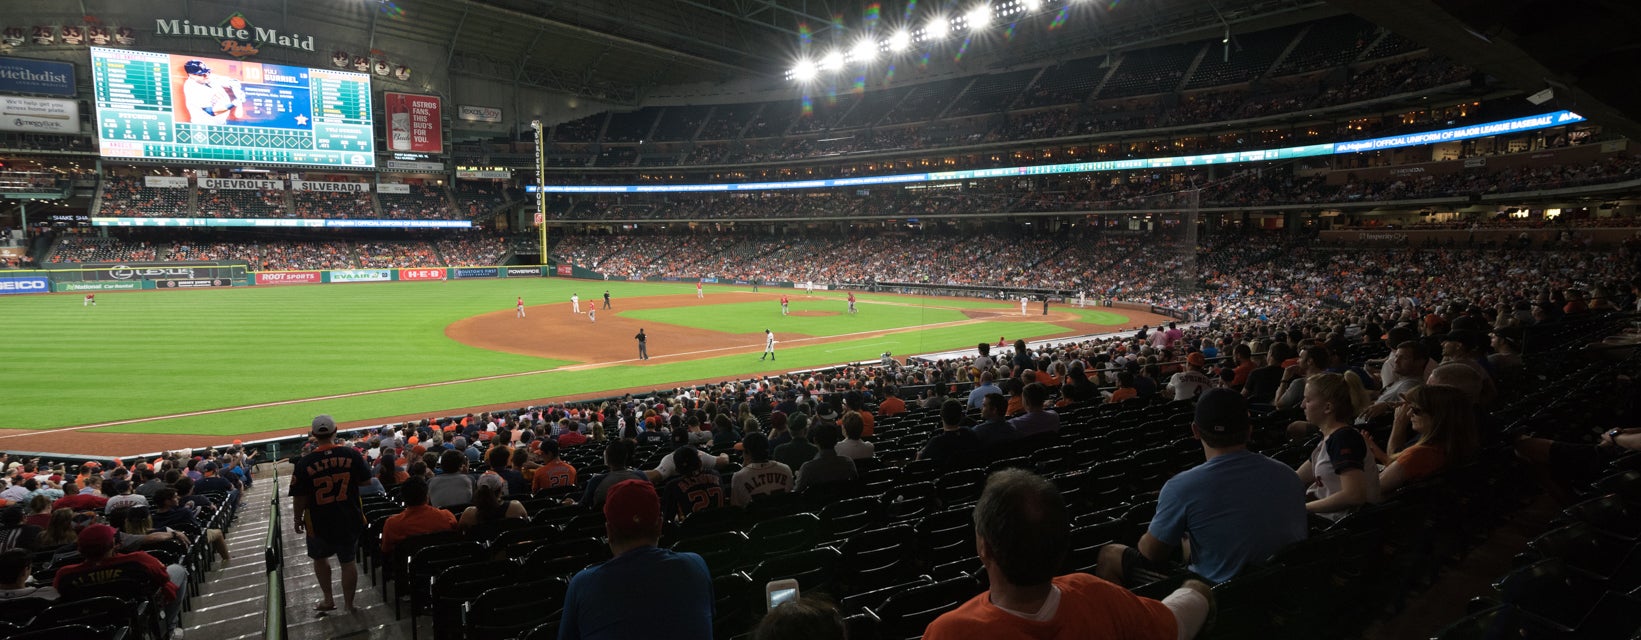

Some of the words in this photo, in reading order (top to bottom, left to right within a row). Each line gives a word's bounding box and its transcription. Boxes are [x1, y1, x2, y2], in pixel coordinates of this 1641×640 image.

[156, 18, 249, 40] Minute
[254, 27, 315, 52] Maid
[0, 68, 67, 83] Methodist
[245, 67, 260, 80] 10
[264, 74, 299, 84] GURRIEL
[412, 101, 437, 109] ASTROS
[412, 108, 431, 116] FANS,
[413, 122, 433, 130] BUD'S
[1376, 137, 1406, 148] OFFICIAL
[1407, 133, 1440, 144] UNIFORM
[1442, 131, 1453, 140] OF
[1454, 127, 1480, 139] MAJOR
[1480, 122, 1510, 135] LEAGUE
[1511, 116, 1552, 131] BASEBALL
[206, 178, 276, 190] CHEVROLET
[301, 182, 362, 192] SILVERADO
[262, 273, 286, 281] ROOT
[0, 280, 45, 290] EICO
[306, 456, 353, 477] ALTUVE
[550, 474, 569, 488] 27
[744, 472, 788, 493] ALTUVE
[312, 471, 351, 506] 27
[687, 486, 724, 512] 27
